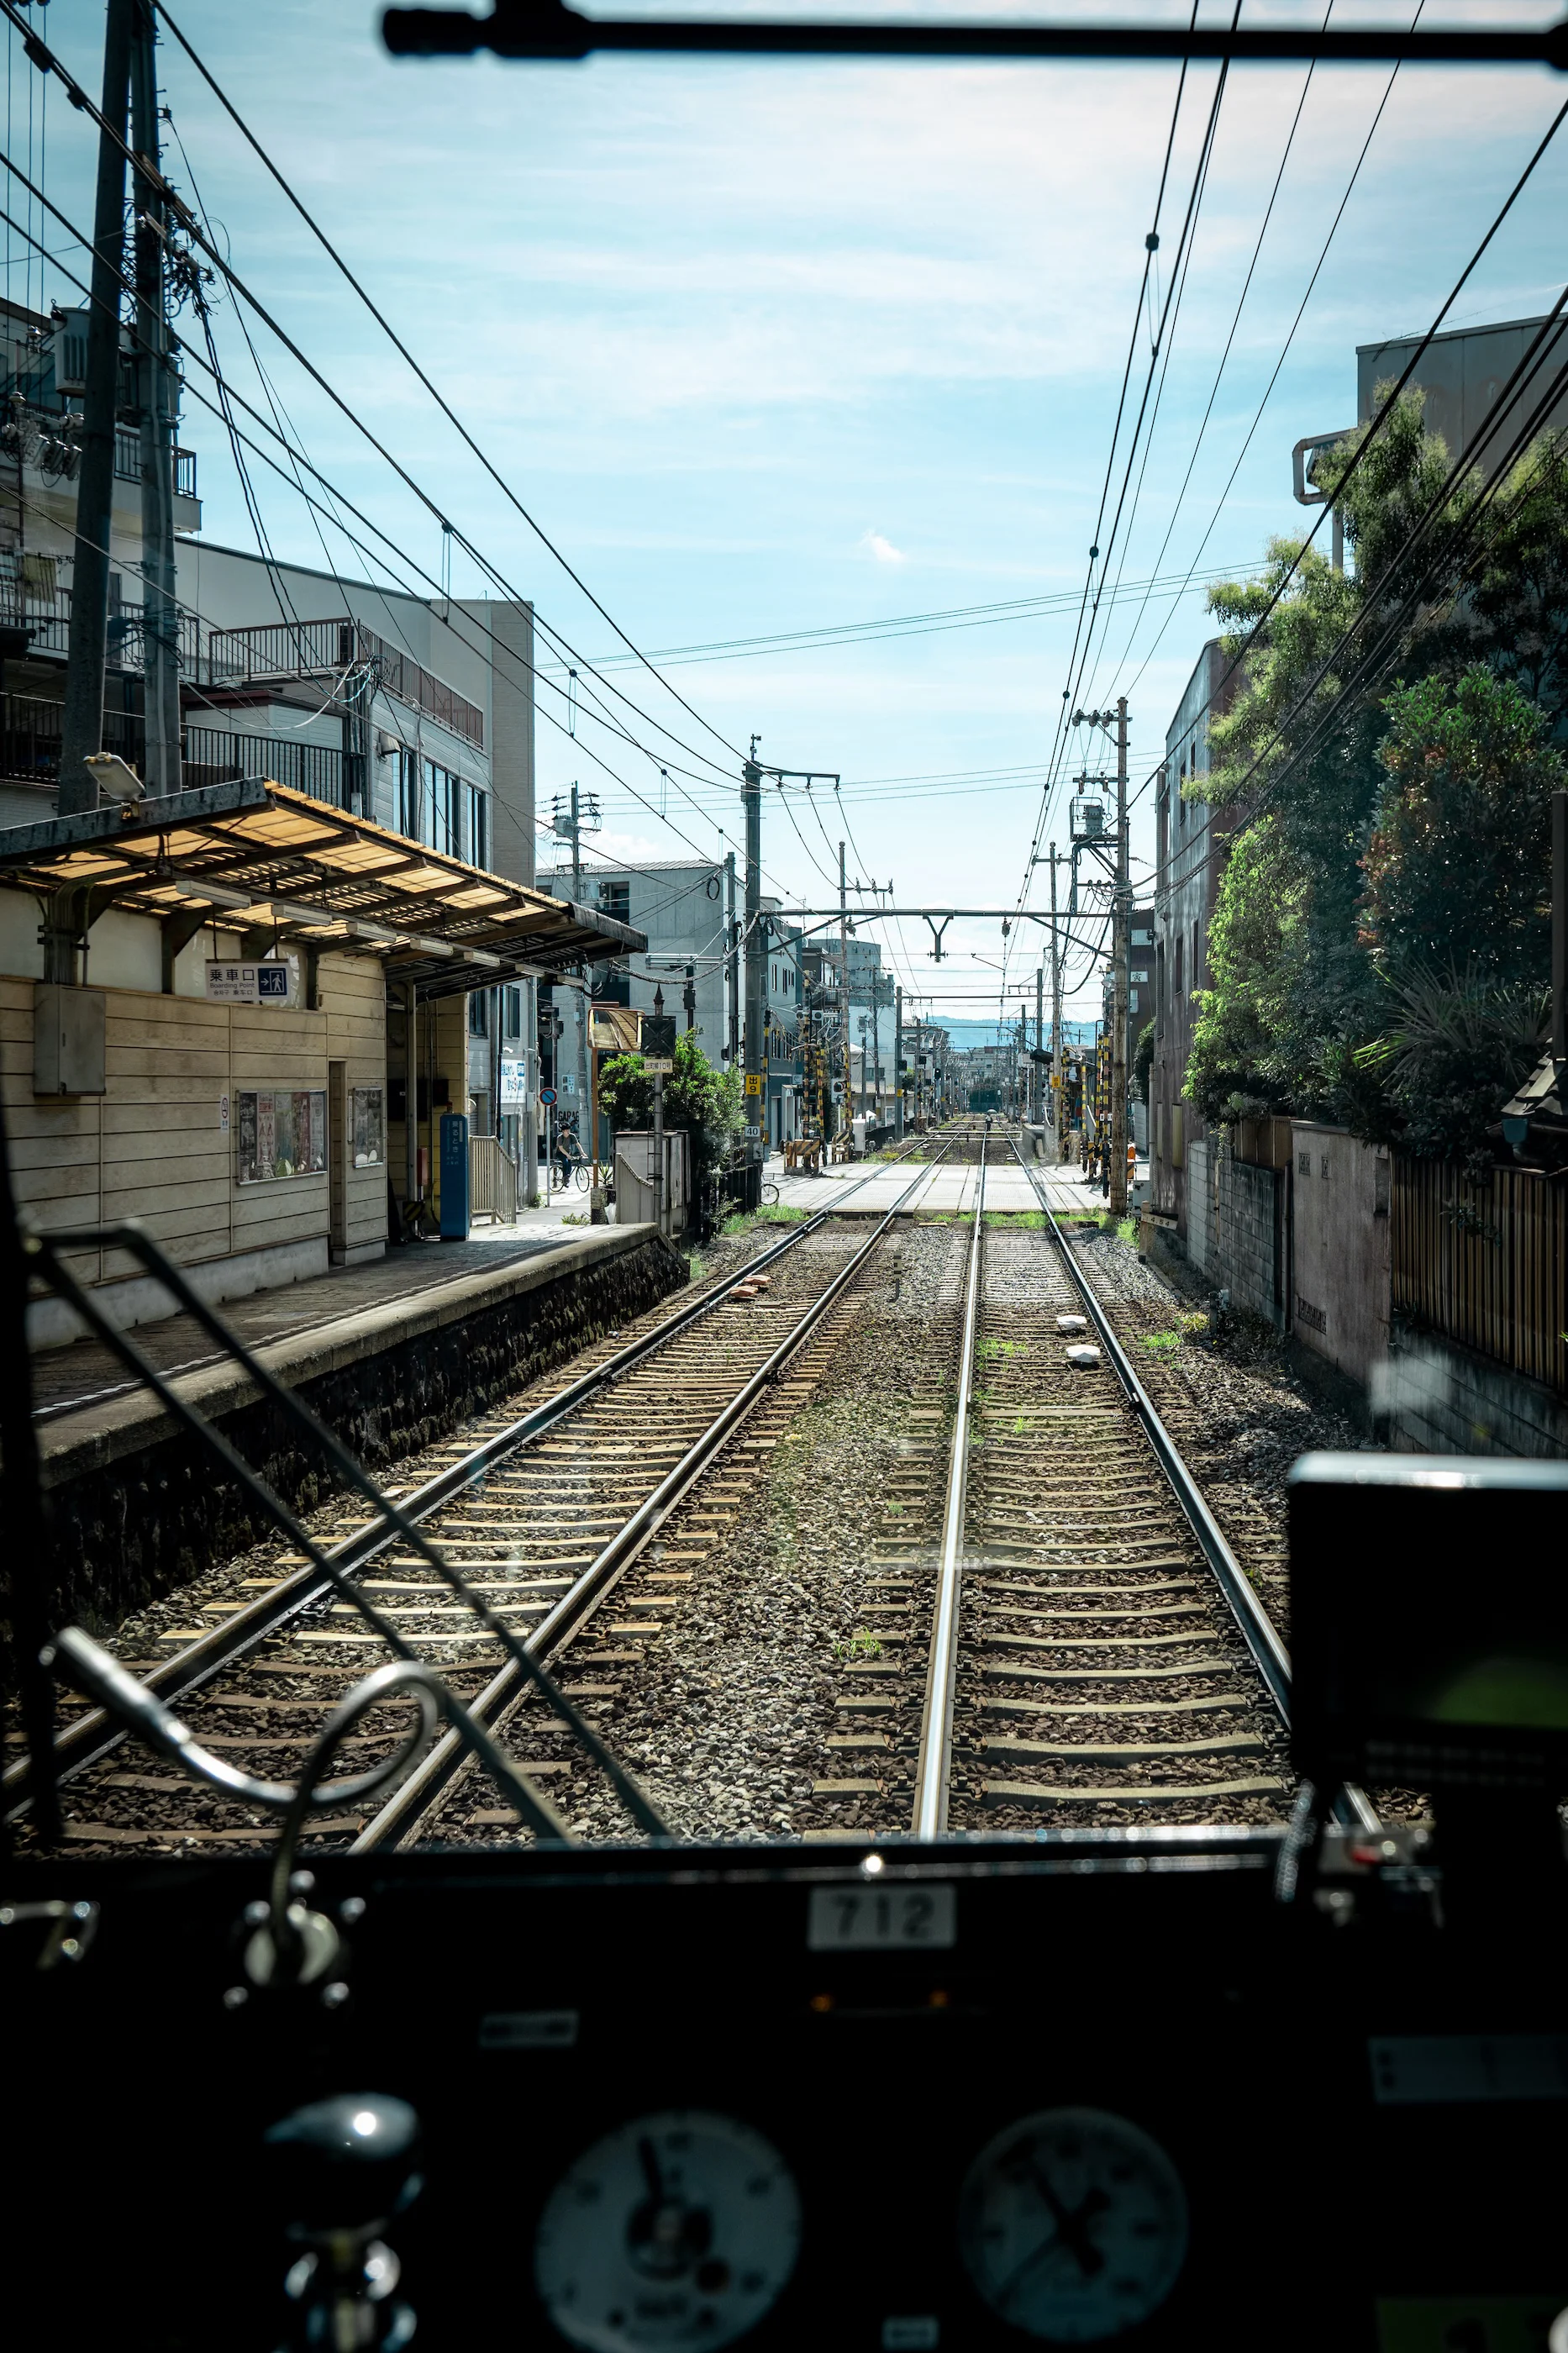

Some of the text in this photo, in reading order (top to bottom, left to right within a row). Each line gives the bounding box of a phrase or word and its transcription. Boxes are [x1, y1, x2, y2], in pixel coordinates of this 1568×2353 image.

[210, 969, 255, 982] 乗車口
[750, 1076, 758, 1085] 出
[830, 1892, 935, 1939] 712
